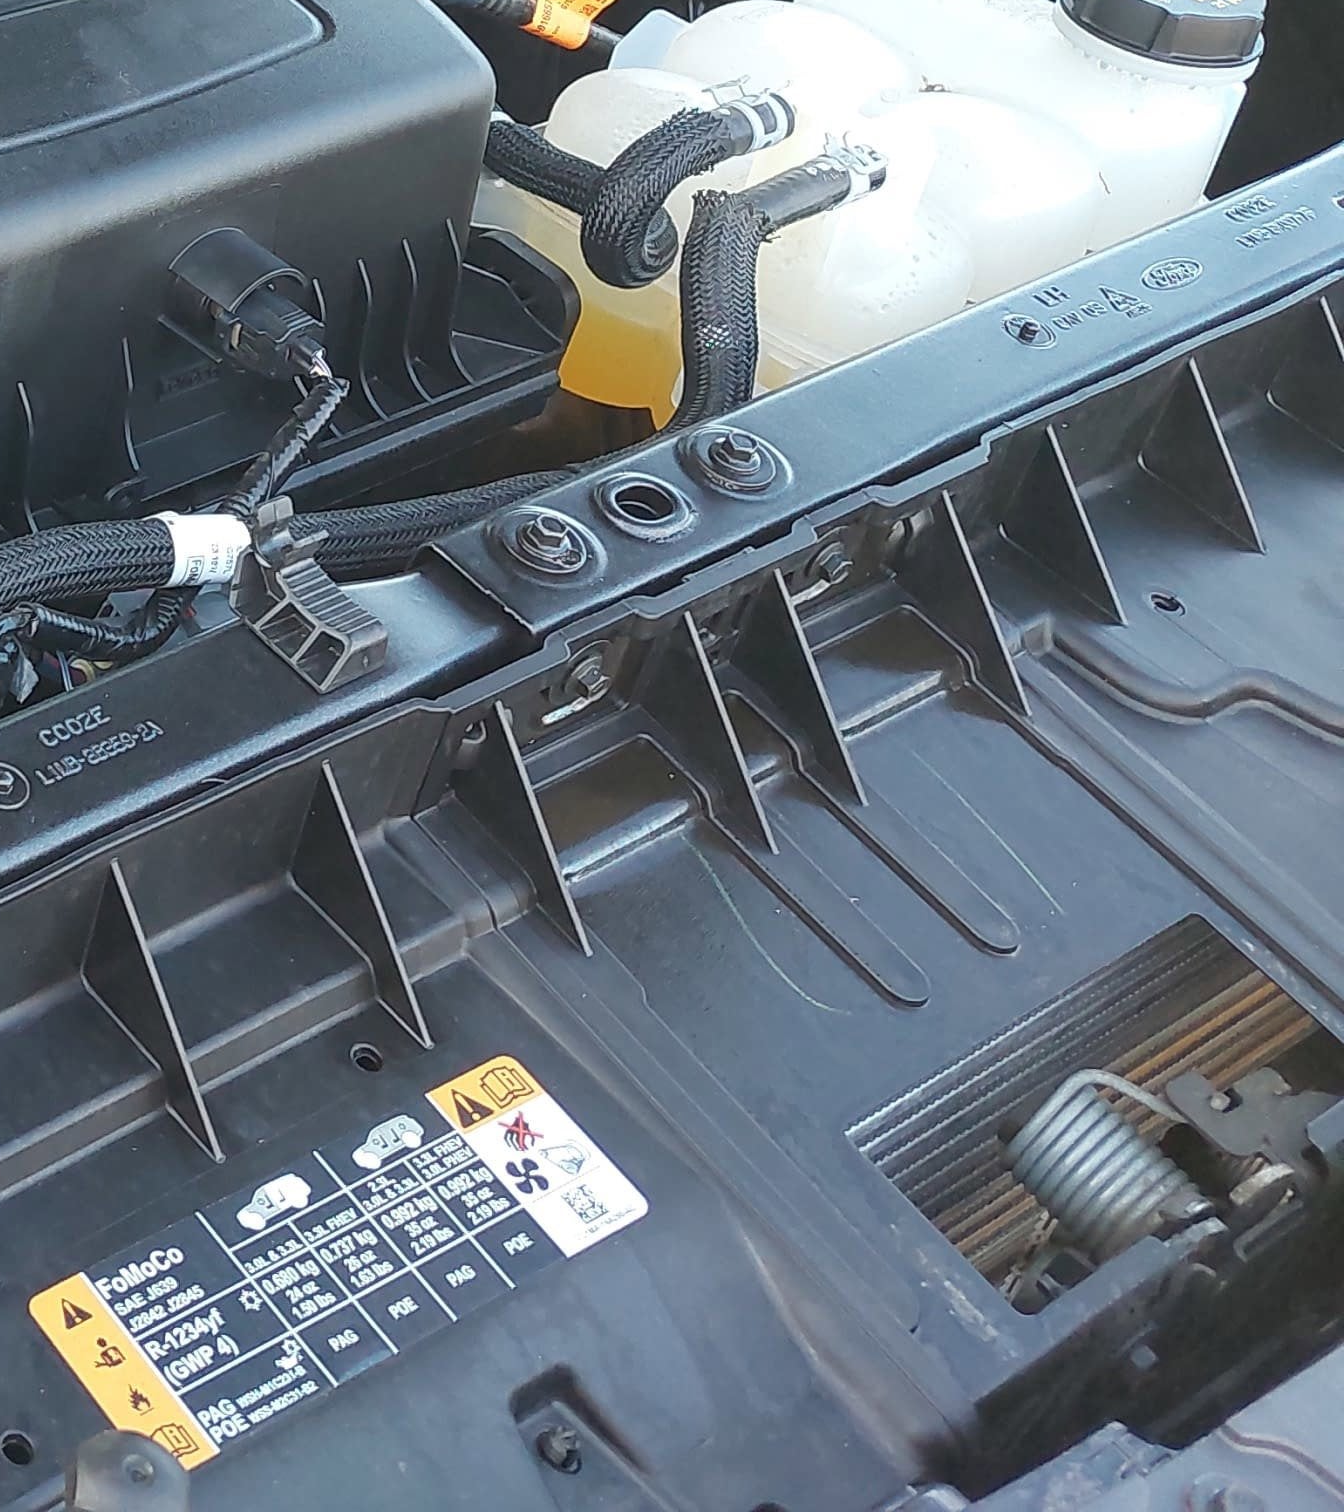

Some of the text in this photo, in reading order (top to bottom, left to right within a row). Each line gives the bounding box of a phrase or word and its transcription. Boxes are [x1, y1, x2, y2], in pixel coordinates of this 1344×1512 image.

[432, 1135, 464, 1160] FHEV
[441, 1143, 474, 1170] PHEV
[437, 1159, 495, 1201] 0.992 kg
[380, 1188, 439, 1230] 0.992 kg
[460, 1186, 495, 1209] 35 oz
[466, 1197, 511, 1226] 2.19 lbs
[325, 1207, 358, 1233] FHEV
[403, 1215, 440, 1238] 35 oz
[319, 1228, 379, 1268] 0.737 kg
[410, 1227, 456, 1256] 2.19 lbs
[503, 1232, 534, 1256] POE
[359, 1249, 378, 1265] oz
[95, 1247, 184, 1304] FoMoCo
[261, 1251, 322, 1295] 0.680 kg
[350, 1261, 394, 1289] 1.63 lbs
[445, 1264, 477, 1288] PAG
[113, 1276, 178, 1317] SAE J639
[285, 1280, 321, 1305] 24 oz
[291, 1292, 337, 1320] 1.50 lbs
[128, 1284, 205, 1334] J2842 J2845
[387, 1296, 419, 1320] POE
[143, 1307, 226, 1365] R-1234yf
[327, 1329, 360, 1352] PAG
[163, 1334, 240, 1391] (GWP 4)
[196, 1398, 237, 1429] PAG
[208, 1412, 251, 1448] POE
